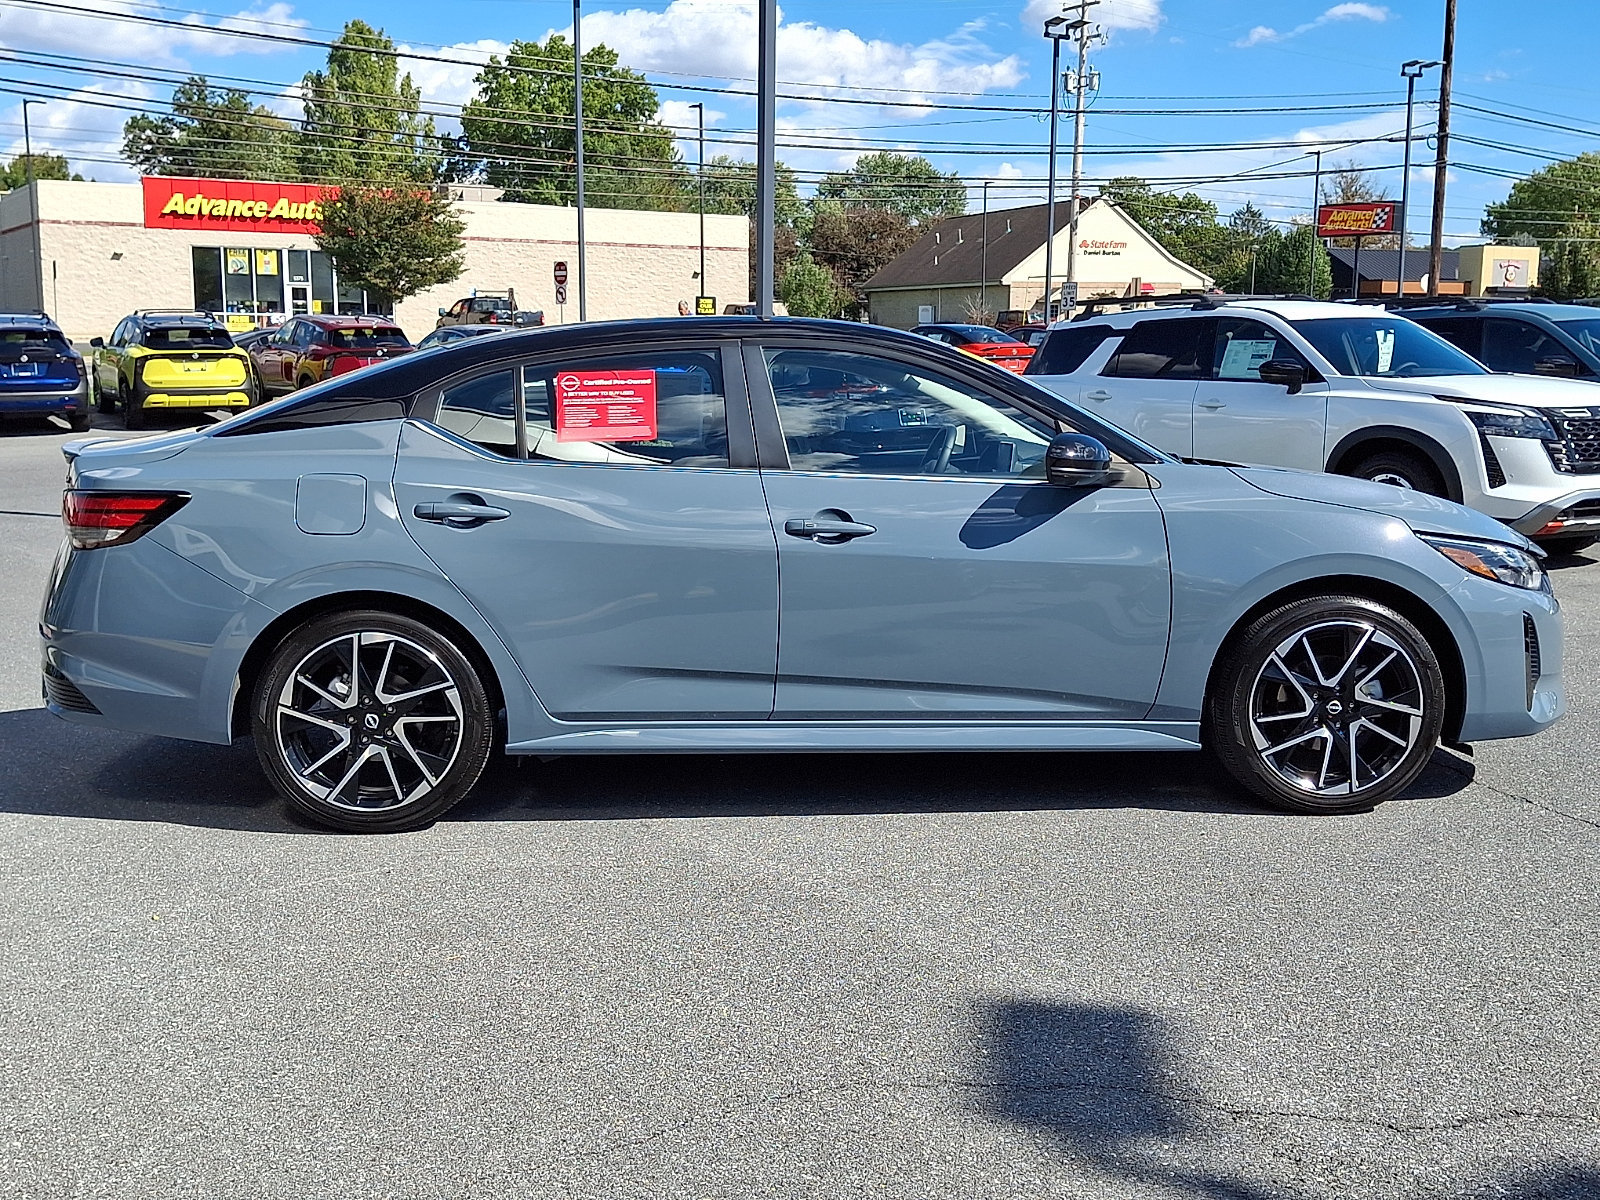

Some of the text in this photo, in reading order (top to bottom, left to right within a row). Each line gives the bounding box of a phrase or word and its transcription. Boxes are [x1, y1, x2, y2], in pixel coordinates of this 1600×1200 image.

[161, 192, 267, 218] Advance
[1328, 210, 1373, 221] Advance
[1324, 219, 1369, 230] Auto Parts
[1090, 240, 1127, 248] State Farm
[1062, 296, 1075, 307] 35
